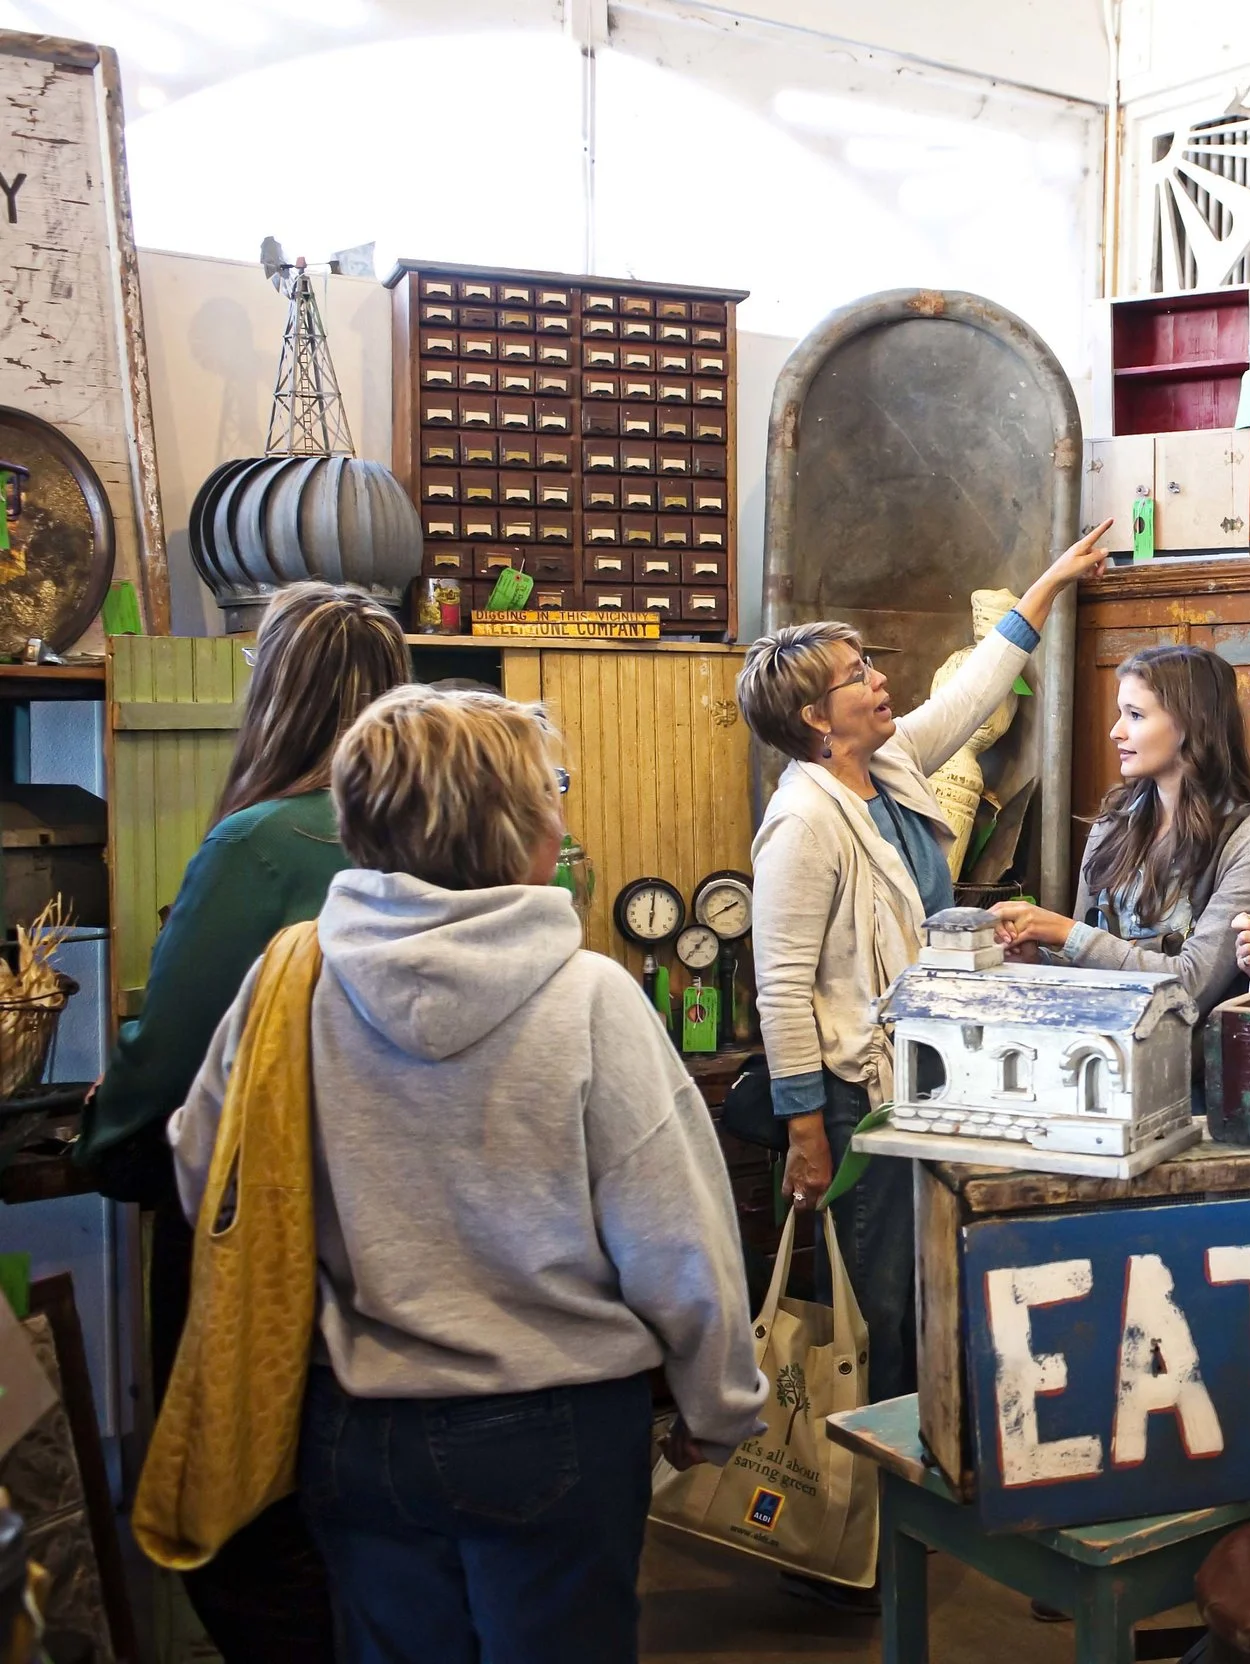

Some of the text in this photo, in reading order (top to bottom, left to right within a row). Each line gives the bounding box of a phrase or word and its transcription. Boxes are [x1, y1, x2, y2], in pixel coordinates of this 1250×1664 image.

[476, 610, 648, 622] DIGGING IN THIS VICINITY
[576, 623, 649, 638] COMPANY
[767, 1448, 785, 1466] all
[786, 1458, 820, 1483] about
[734, 1455, 817, 1497] saving green
[753, 1511, 771, 1524] ALDI
